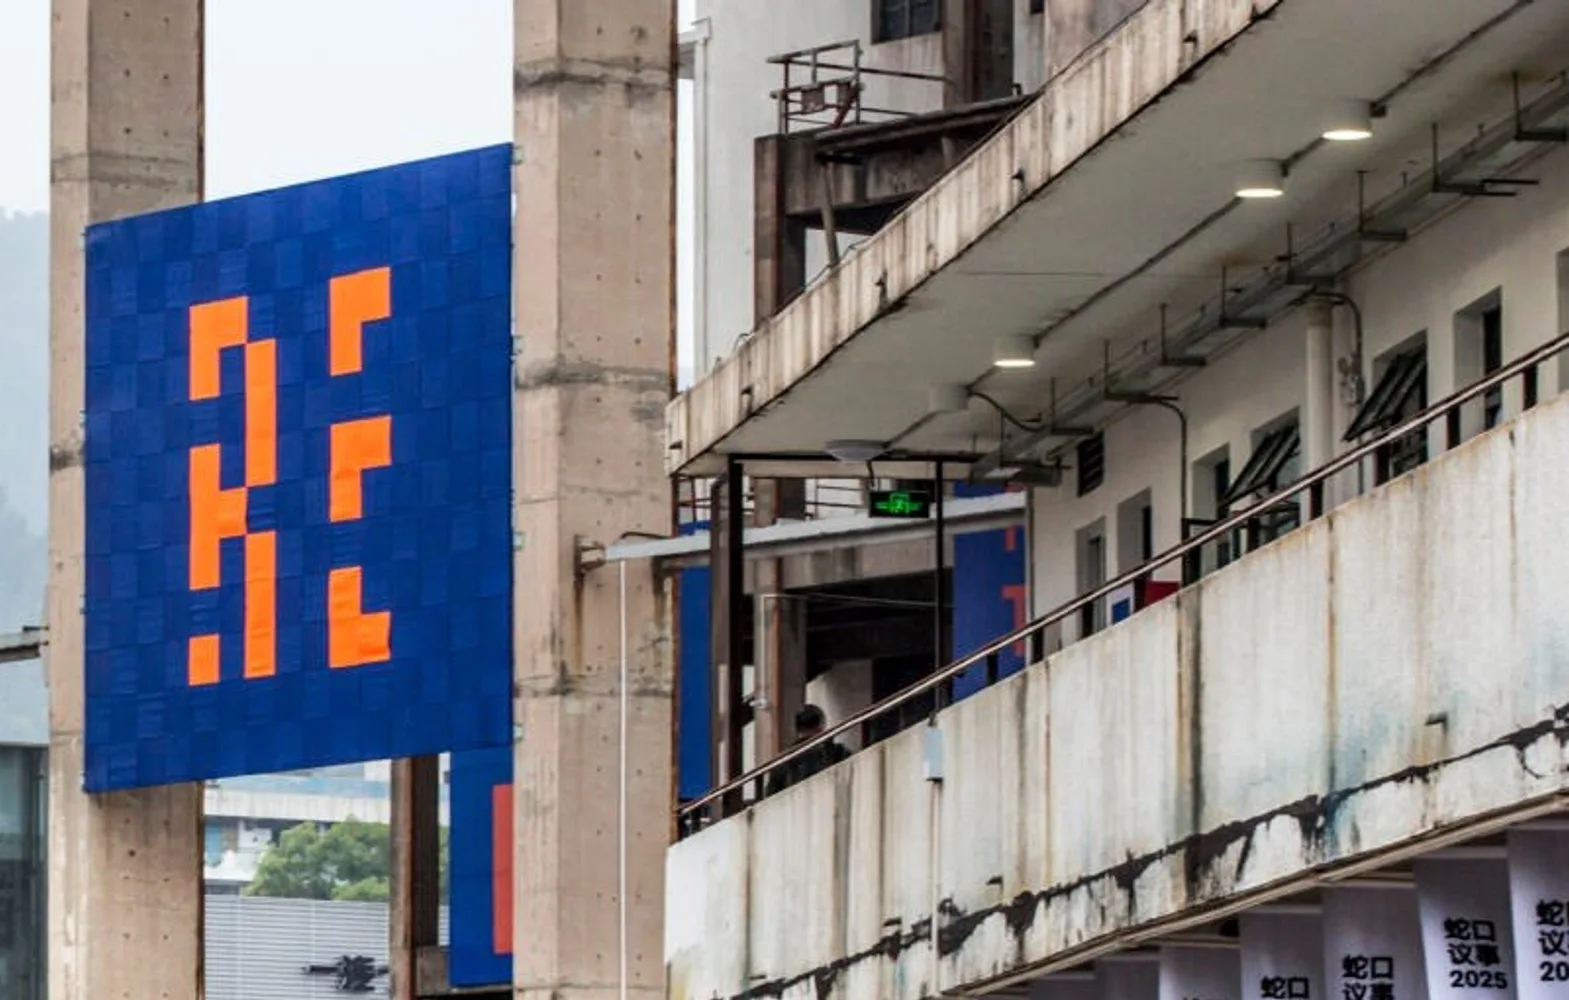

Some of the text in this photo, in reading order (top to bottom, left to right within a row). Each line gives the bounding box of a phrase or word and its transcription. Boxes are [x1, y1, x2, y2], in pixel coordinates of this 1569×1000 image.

[1536, 898, 1569, 927] 蛇
[1443, 918, 1496, 942] 蛇口
[1538, 930, 1569, 956] 议
[1342, 954, 1394, 980] 蛇口
[1447, 944, 1500, 968] 议事
[1261, 976, 1310, 1000] 蛇口
[1450, 970, 1508, 990] 2025
